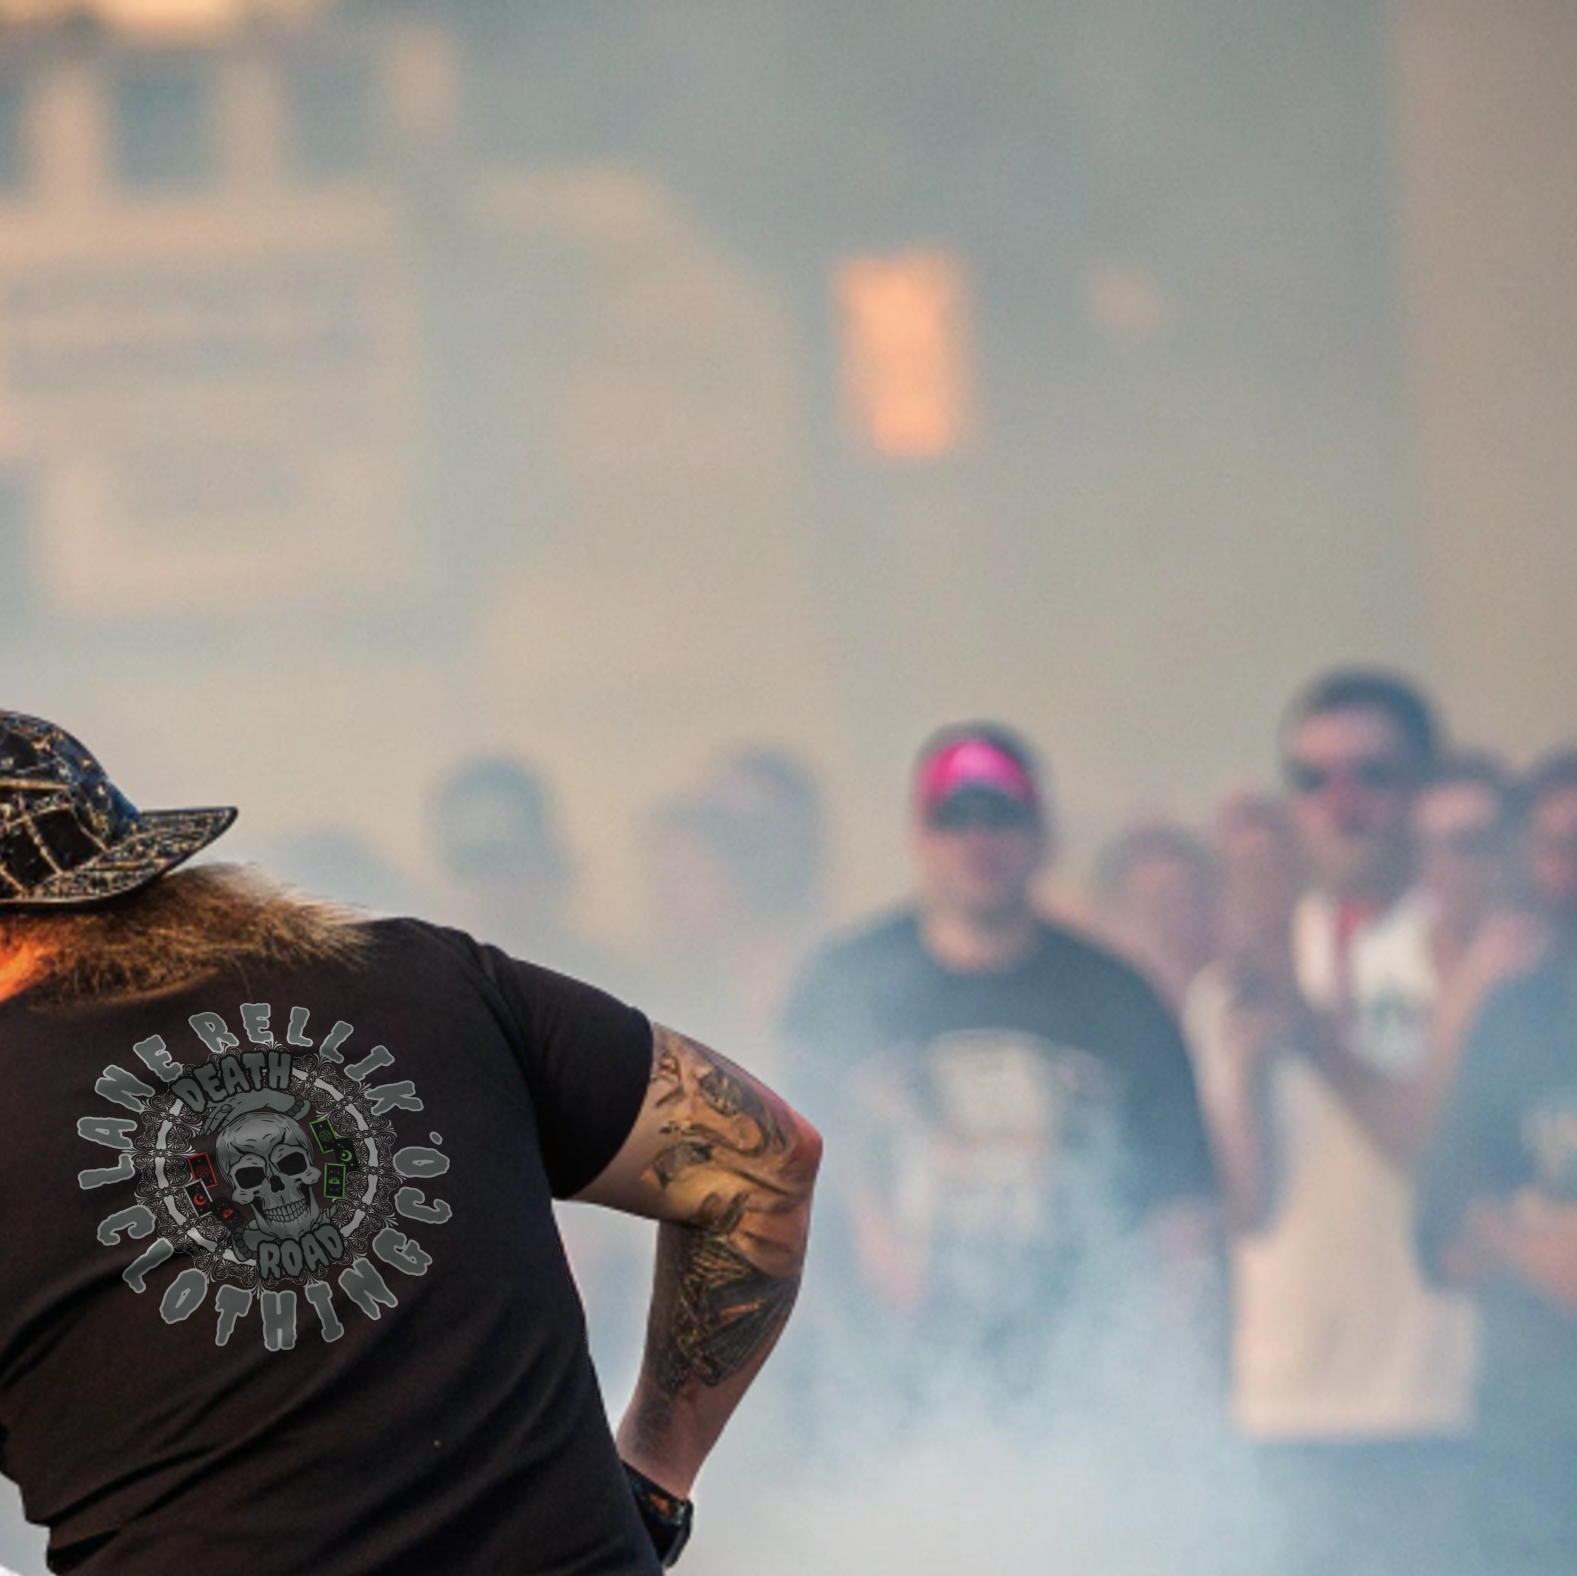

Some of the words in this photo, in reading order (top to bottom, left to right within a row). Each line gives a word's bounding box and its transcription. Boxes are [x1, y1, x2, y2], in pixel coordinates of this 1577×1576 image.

[77, 1034, 184, 1190] LANE
[188, 1003, 424, 1115] RELLIK
[169, 1051, 293, 1115] DEATH
[96, 1204, 433, 1351] CLOTHING
[257, 1223, 346, 1280] ROAD
